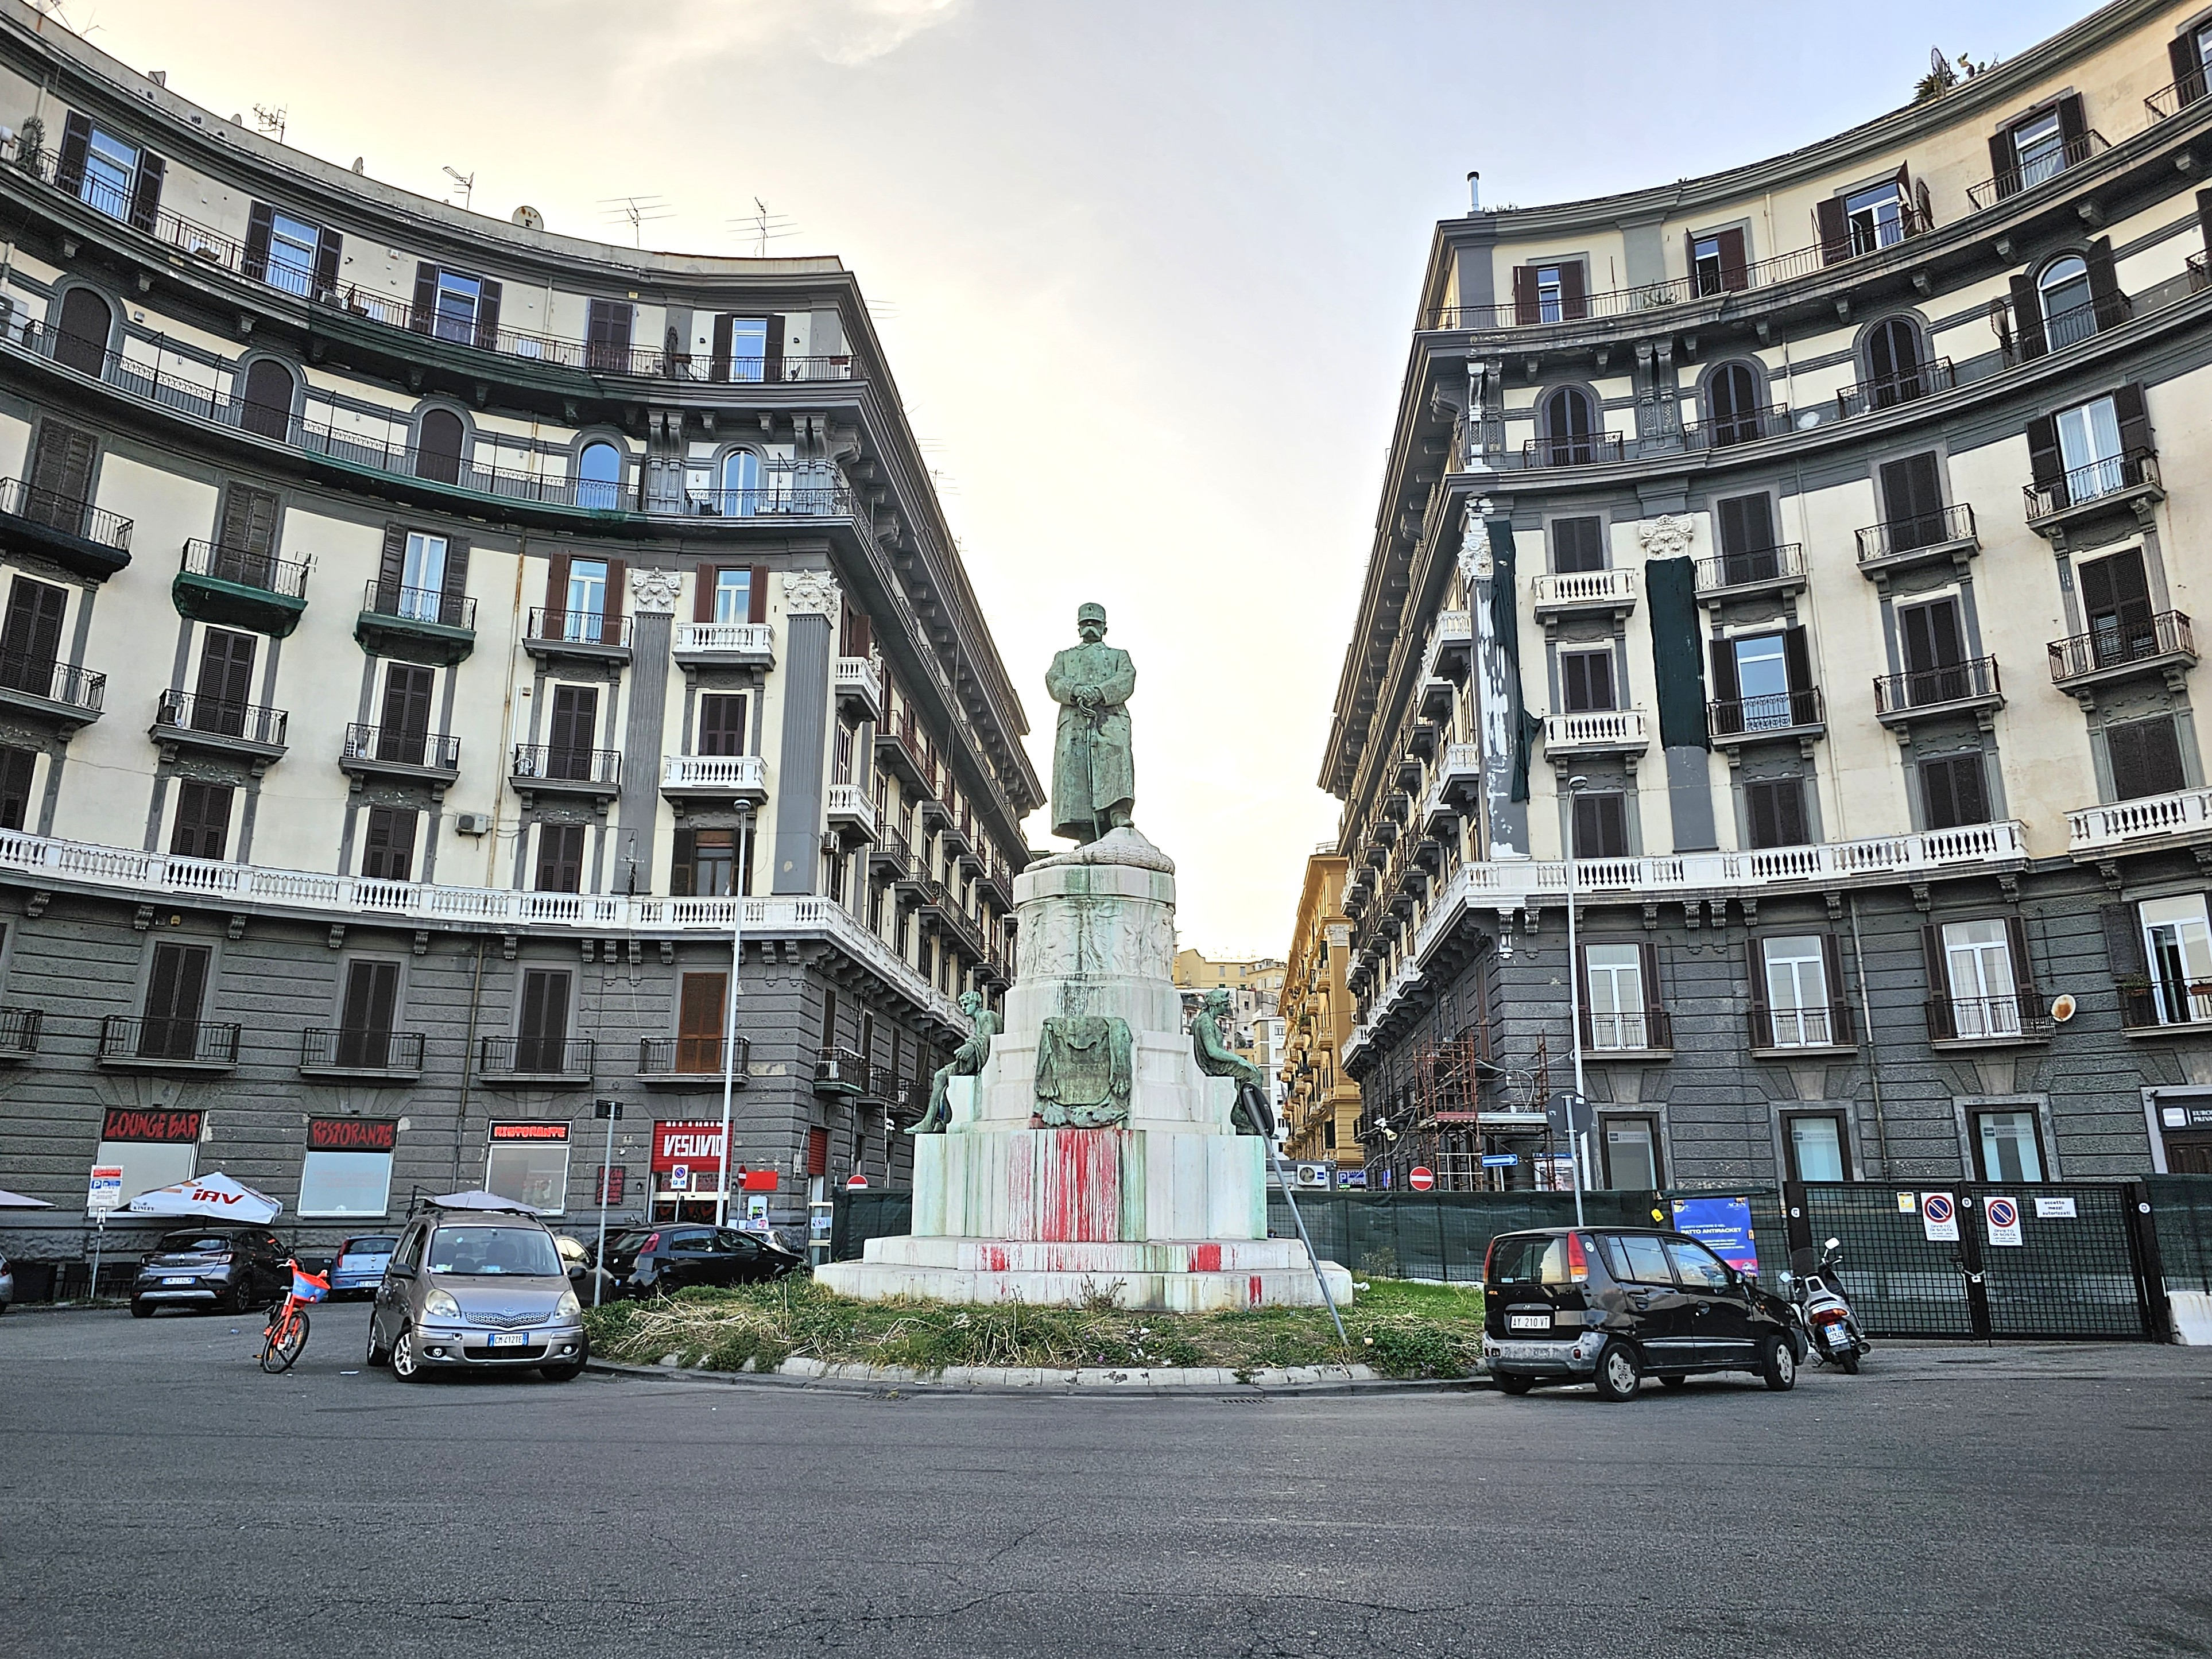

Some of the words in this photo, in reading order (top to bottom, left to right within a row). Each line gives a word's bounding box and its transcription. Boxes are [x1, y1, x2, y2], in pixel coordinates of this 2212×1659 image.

[105, 1111, 166, 1138] LOUNGE
[167, 1113, 199, 1139] BAR
[494, 1126, 565, 1137] RISTORANTE
[1513, 1318, 1521, 1326] AY
[1525, 1318, 1537, 1327] 210
[1540, 1318, 1548, 1326] VT
